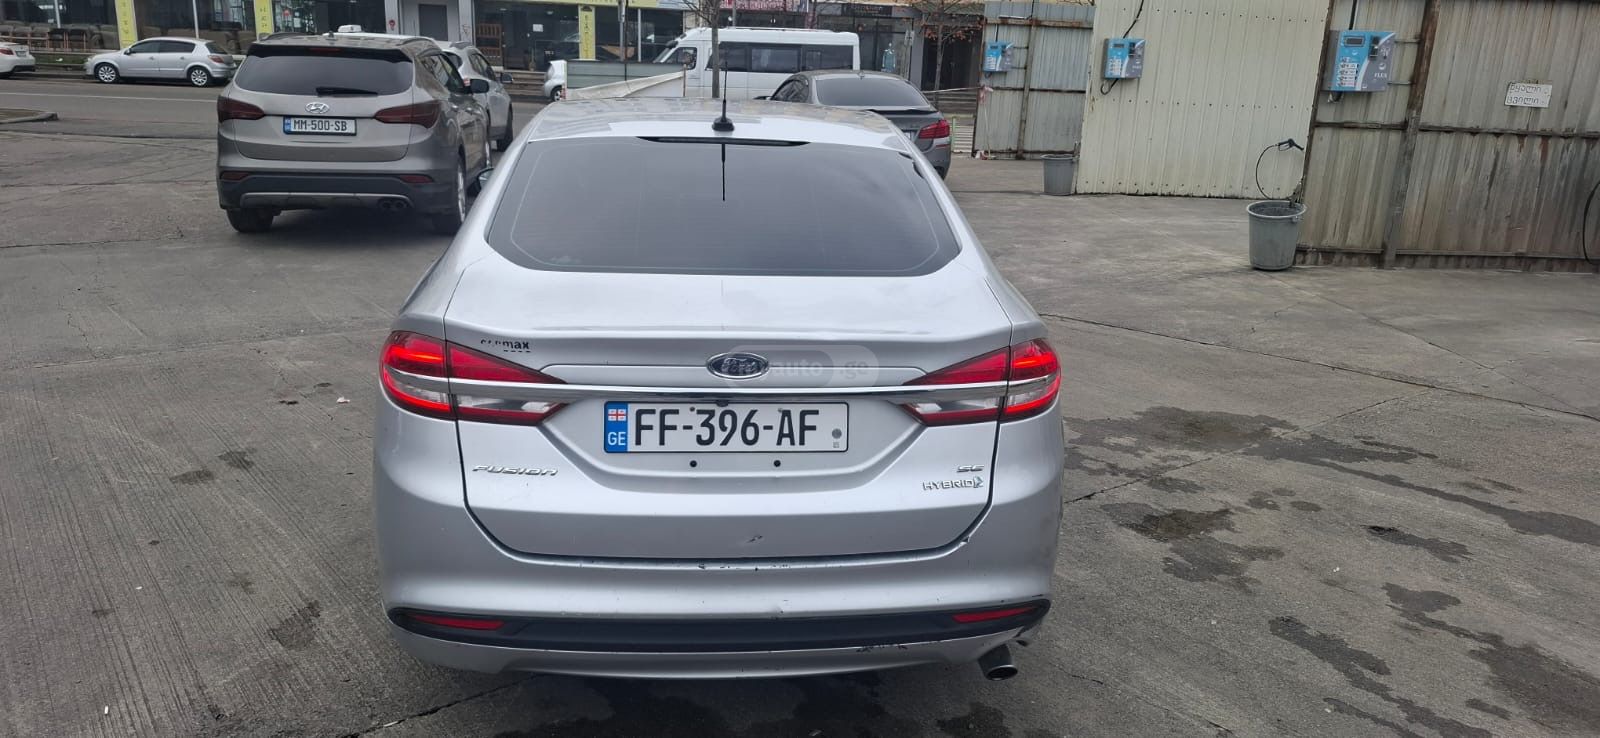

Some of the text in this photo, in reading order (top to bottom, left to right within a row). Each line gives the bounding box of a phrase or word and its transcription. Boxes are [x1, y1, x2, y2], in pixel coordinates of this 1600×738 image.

[293, 119, 348, 132] MM-500-SB
[634, 408, 820, 447] FF-396-AF
[607, 431, 627, 446] GE
[956, 464, 985, 473] SE
[922, 480, 975, 490] HYBRID
